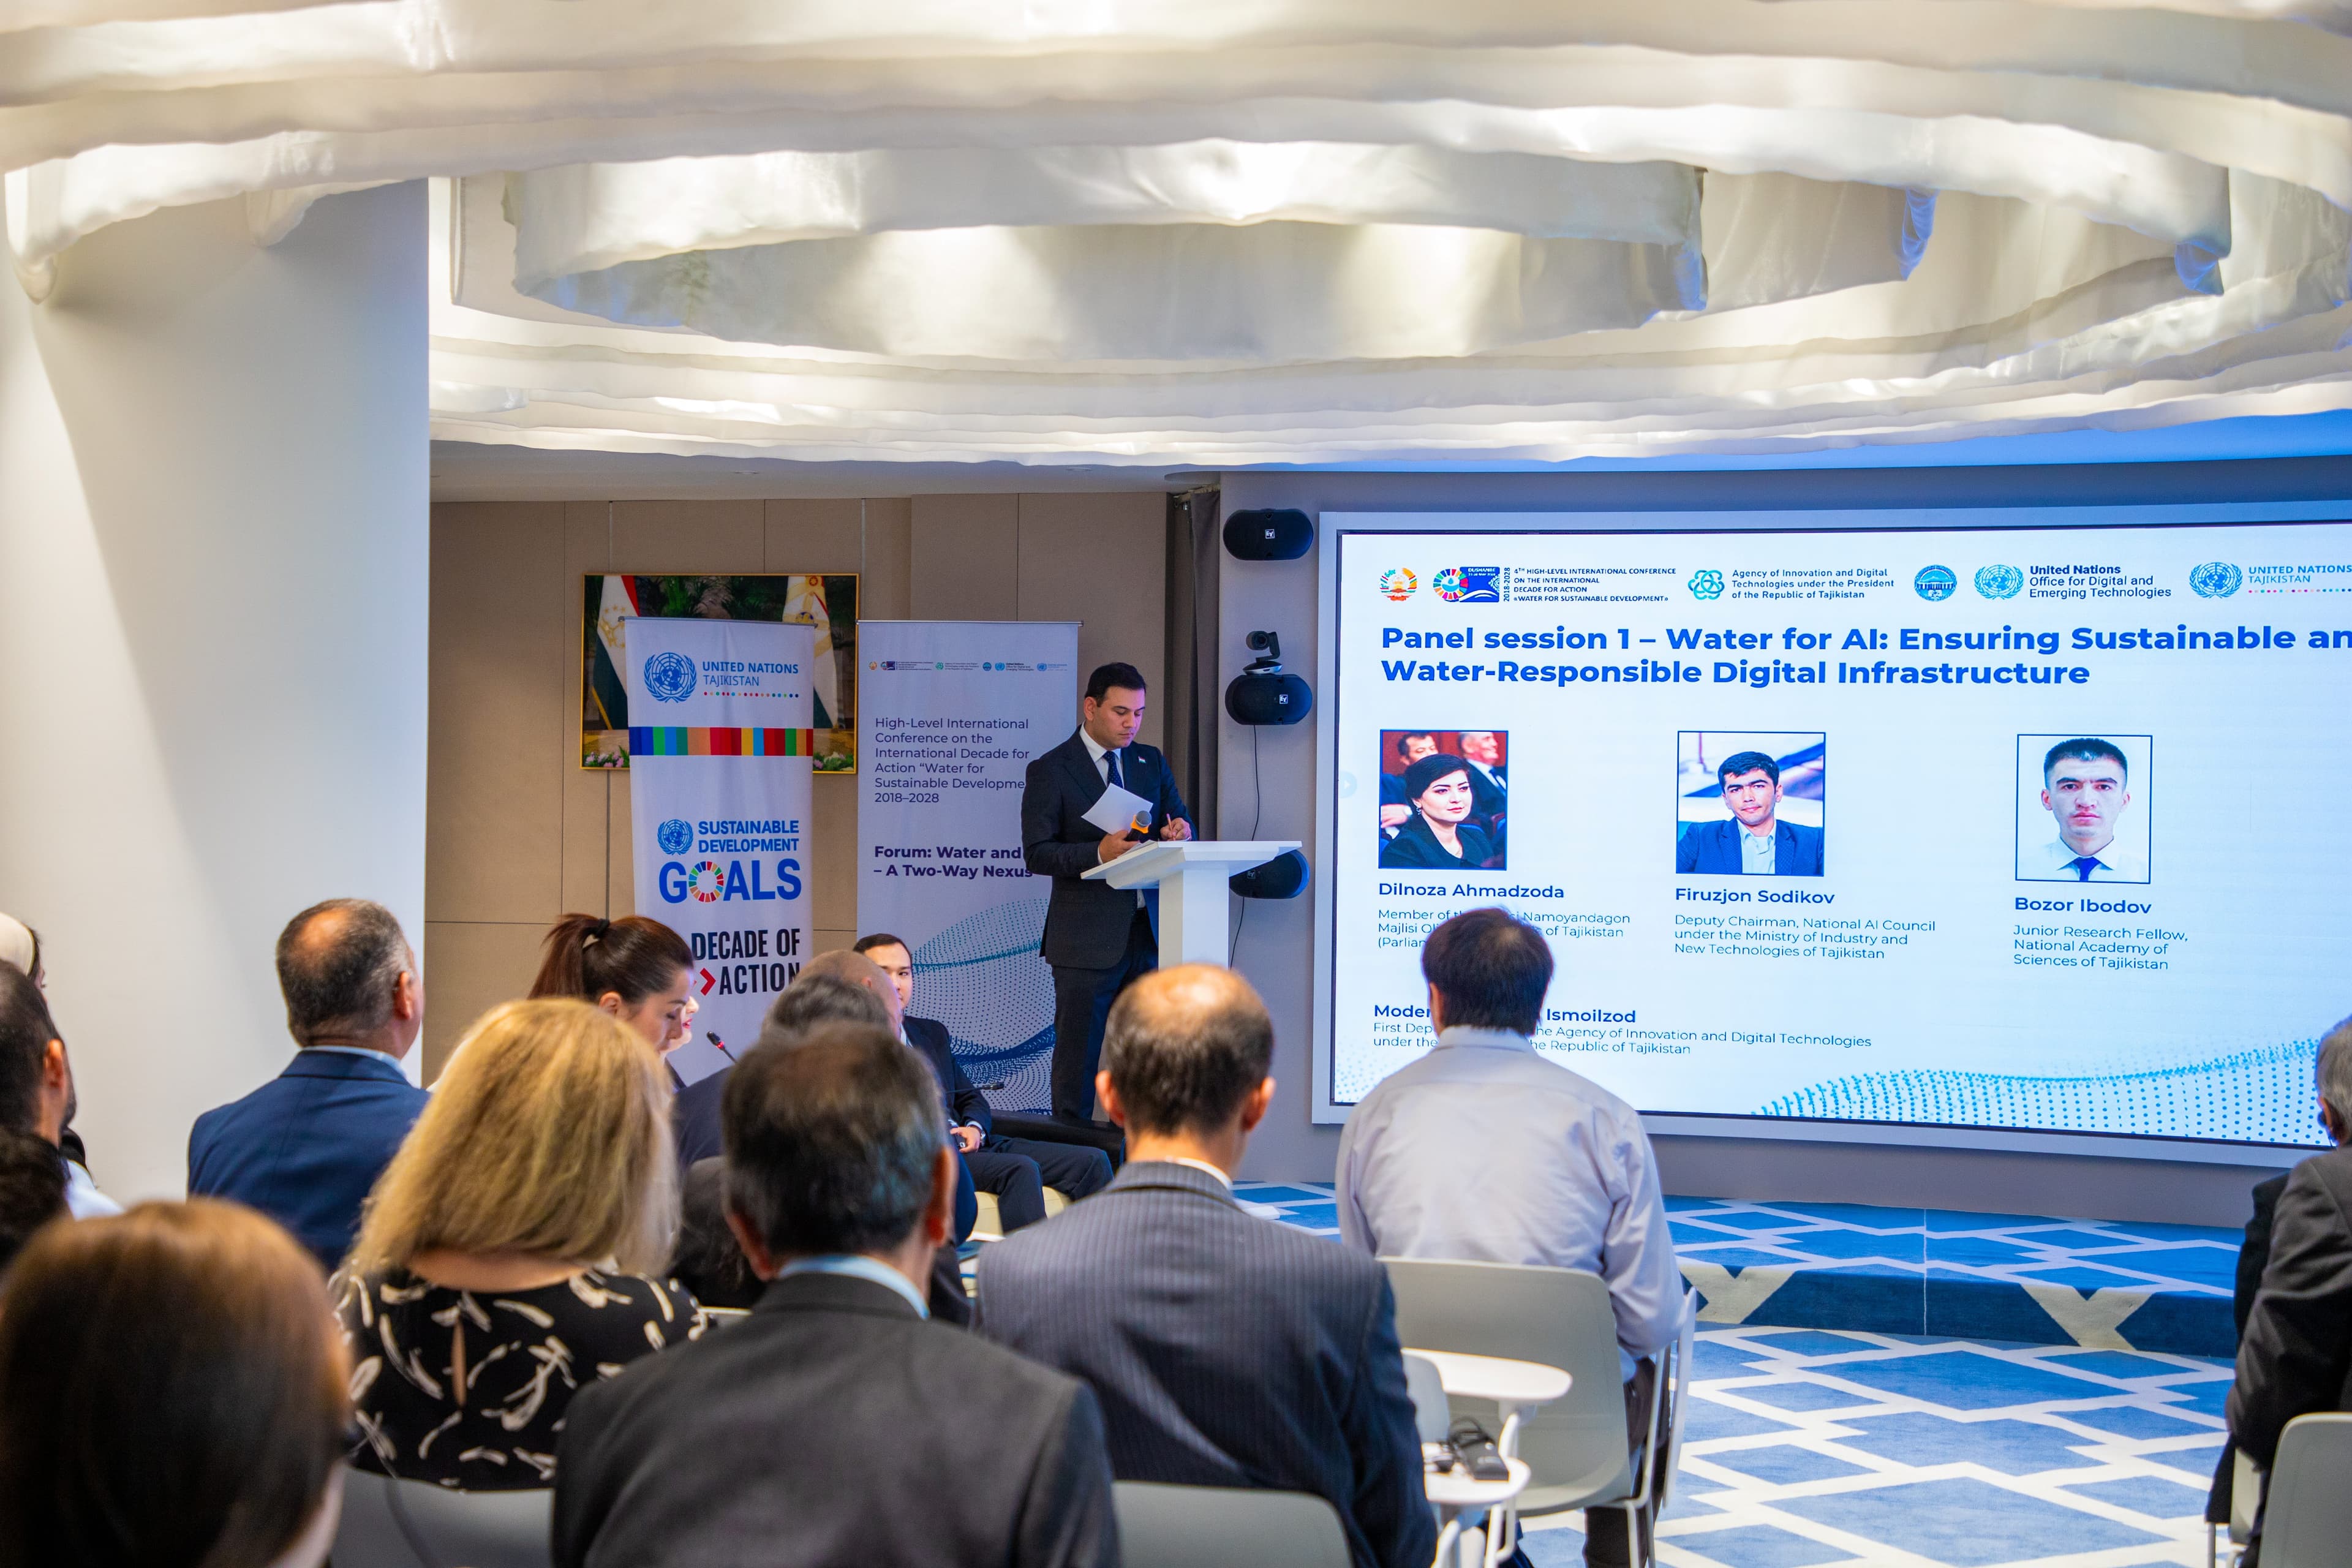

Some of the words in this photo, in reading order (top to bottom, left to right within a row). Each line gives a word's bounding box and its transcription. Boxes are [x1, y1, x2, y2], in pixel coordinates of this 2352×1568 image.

[1733, 570, 1767, 578] Agency
[1857, 569, 1887, 578] Digital
[2030, 565, 2070, 575] United
[2073, 565, 2120, 574] Nations
[1732, 581, 1794, 589] Technologies
[2030, 576, 2064, 586] Office
[2069, 576, 2085, 586] for
[2089, 576, 2127, 587] Digital
[2131, 576, 2153, 585] and
[2249, 575, 2310, 585] TAJIKISTAN
[1763, 591, 1803, 600] Republic
[1819, 591, 1864, 600] Tajikistan
[2030, 589, 2086, 600] Emerging
[2090, 587, 2171, 598] Technologies
[1383, 627, 1472, 648] Panel
[1485, 625, 1607, 649] session
[1618, 629, 1629, 649] 1
[1666, 629, 1773, 649] Water
[1782, 627, 1832, 649] for
[1841, 629, 1888, 649] AI:
[1901, 625, 2059, 655] Ensuring
[2071, 624, 2296, 649] Sustainable
[2309, 631, 2352, 648] an
[703, 662, 744, 672] UNITED
[748, 663, 798, 674] NATIONS
[1381, 659, 1702, 687] Water-Responsible
[1714, 659, 1825, 688] Digital
[1839, 661, 2089, 684] Infrastructure
[703, 675, 759, 687] TAJIKISTAN
[876, 717, 942, 729] High-Level
[948, 718, 1028, 728] International
[876, 733, 948, 743] Conference
[971, 733, 992, 743] the
[876, 748, 956, 758] International
[961, 748, 1009, 758] Decade
[1012, 748, 1029, 758] for
[875, 763, 915, 772] Action
[920, 763, 963, 773] “Water
[967, 763, 984, 773] for
[875, 778, 948, 788] Sustainable
[953, 778, 1025, 791] Developme
[699, 820, 799, 835] SUSTAINABLE
[699, 839, 799, 853] DEVELOPMENT
[875, 846, 931, 858] Forum:
[937, 846, 986, 858] Water
[991, 847, 1021, 859] and
[886, 865, 898, 876] A
[902, 865, 978, 880] Two-Way
[983, 865, 1033, 877] Nexus
[659, 859, 802, 903] GOALS
[1379, 883, 1446, 895] Dilnoza
[1452, 884, 1564, 897] Ahmadzoda
[1676, 888, 1751, 904] Firuzjon
[1758, 891, 1834, 903] Sodikov
[2016, 897, 2074, 911] Bozor
[2081, 899, 2151, 913] Ibodov
[1379, 910, 1433, 919] Member
[1438, 910, 1450, 919] of
[1524, 912, 1630, 924] Namoyandagon
[1676, 915, 1724, 927] Deputy
[1728, 916, 1798, 928] Chairman,
[1804, 919, 1860, 929] National
[1865, 920, 1877, 929] AI
[1883, 920, 1935, 931] Council
[1379, 923, 1417, 935] Majlisi
[1421, 923, 1438, 933] Ol
[1546, 926, 1559, 935] of
[1562, 927, 1623, 938] Tajikistan
[2014, 925, 2059, 936] Junior
[2064, 927, 2131, 938] Research
[2136, 929, 2187, 941] Fellow,
[692, 930, 768, 960] DECADE
[777, 929, 800, 956] OF
[1675, 930, 1714, 939] under
[1719, 930, 1741, 940] the
[1746, 931, 1800, 944] Ministry
[1804, 932, 1817, 941] of
[1821, 933, 1877, 946] Industry
[1882, 935, 1907, 944] and
[1676, 944, 1705, 953] New
[1709, 944, 1799, 957] Technologies
[1803, 946, 1817, 956] of
[1820, 948, 1884, 959] Tajikistan
[2015, 940, 2074, 951] National
[2079, 941, 2149, 956] Academy
[2154, 944, 2168, 954] of
[2015, 954, 2077, 966] Sciences
[2081, 956, 2095, 967] of
[2099, 957, 2168, 970] Tajikistan
[1374, 1005, 1430, 1017] Moder
[1547, 1009, 1635, 1022] Ismoilzod
[1374, 1023, 1401, 1032] First
[1406, 1023, 1433, 1035] Dep
[1536, 1026, 1552, 1036] he
[1556, 1027, 1606, 1039] Agency
[1610, 1028, 1623, 1038] of
[1627, 1029, 1697, 1040] Innovation
[1702, 1031, 1726, 1041] and
[1732, 1032, 1775, 1044] Digital
[1780, 1034, 1871, 1048] Technologies
[1374, 1037, 1411, 1046] under
[1417, 1037, 1438, 1046] the
[1530, 1039, 1546, 1050] he
[1551, 1041, 1608, 1052] Republic
[1612, 1042, 1625, 1052] of
[1629, 1043, 1690, 1054] Tajikistan
